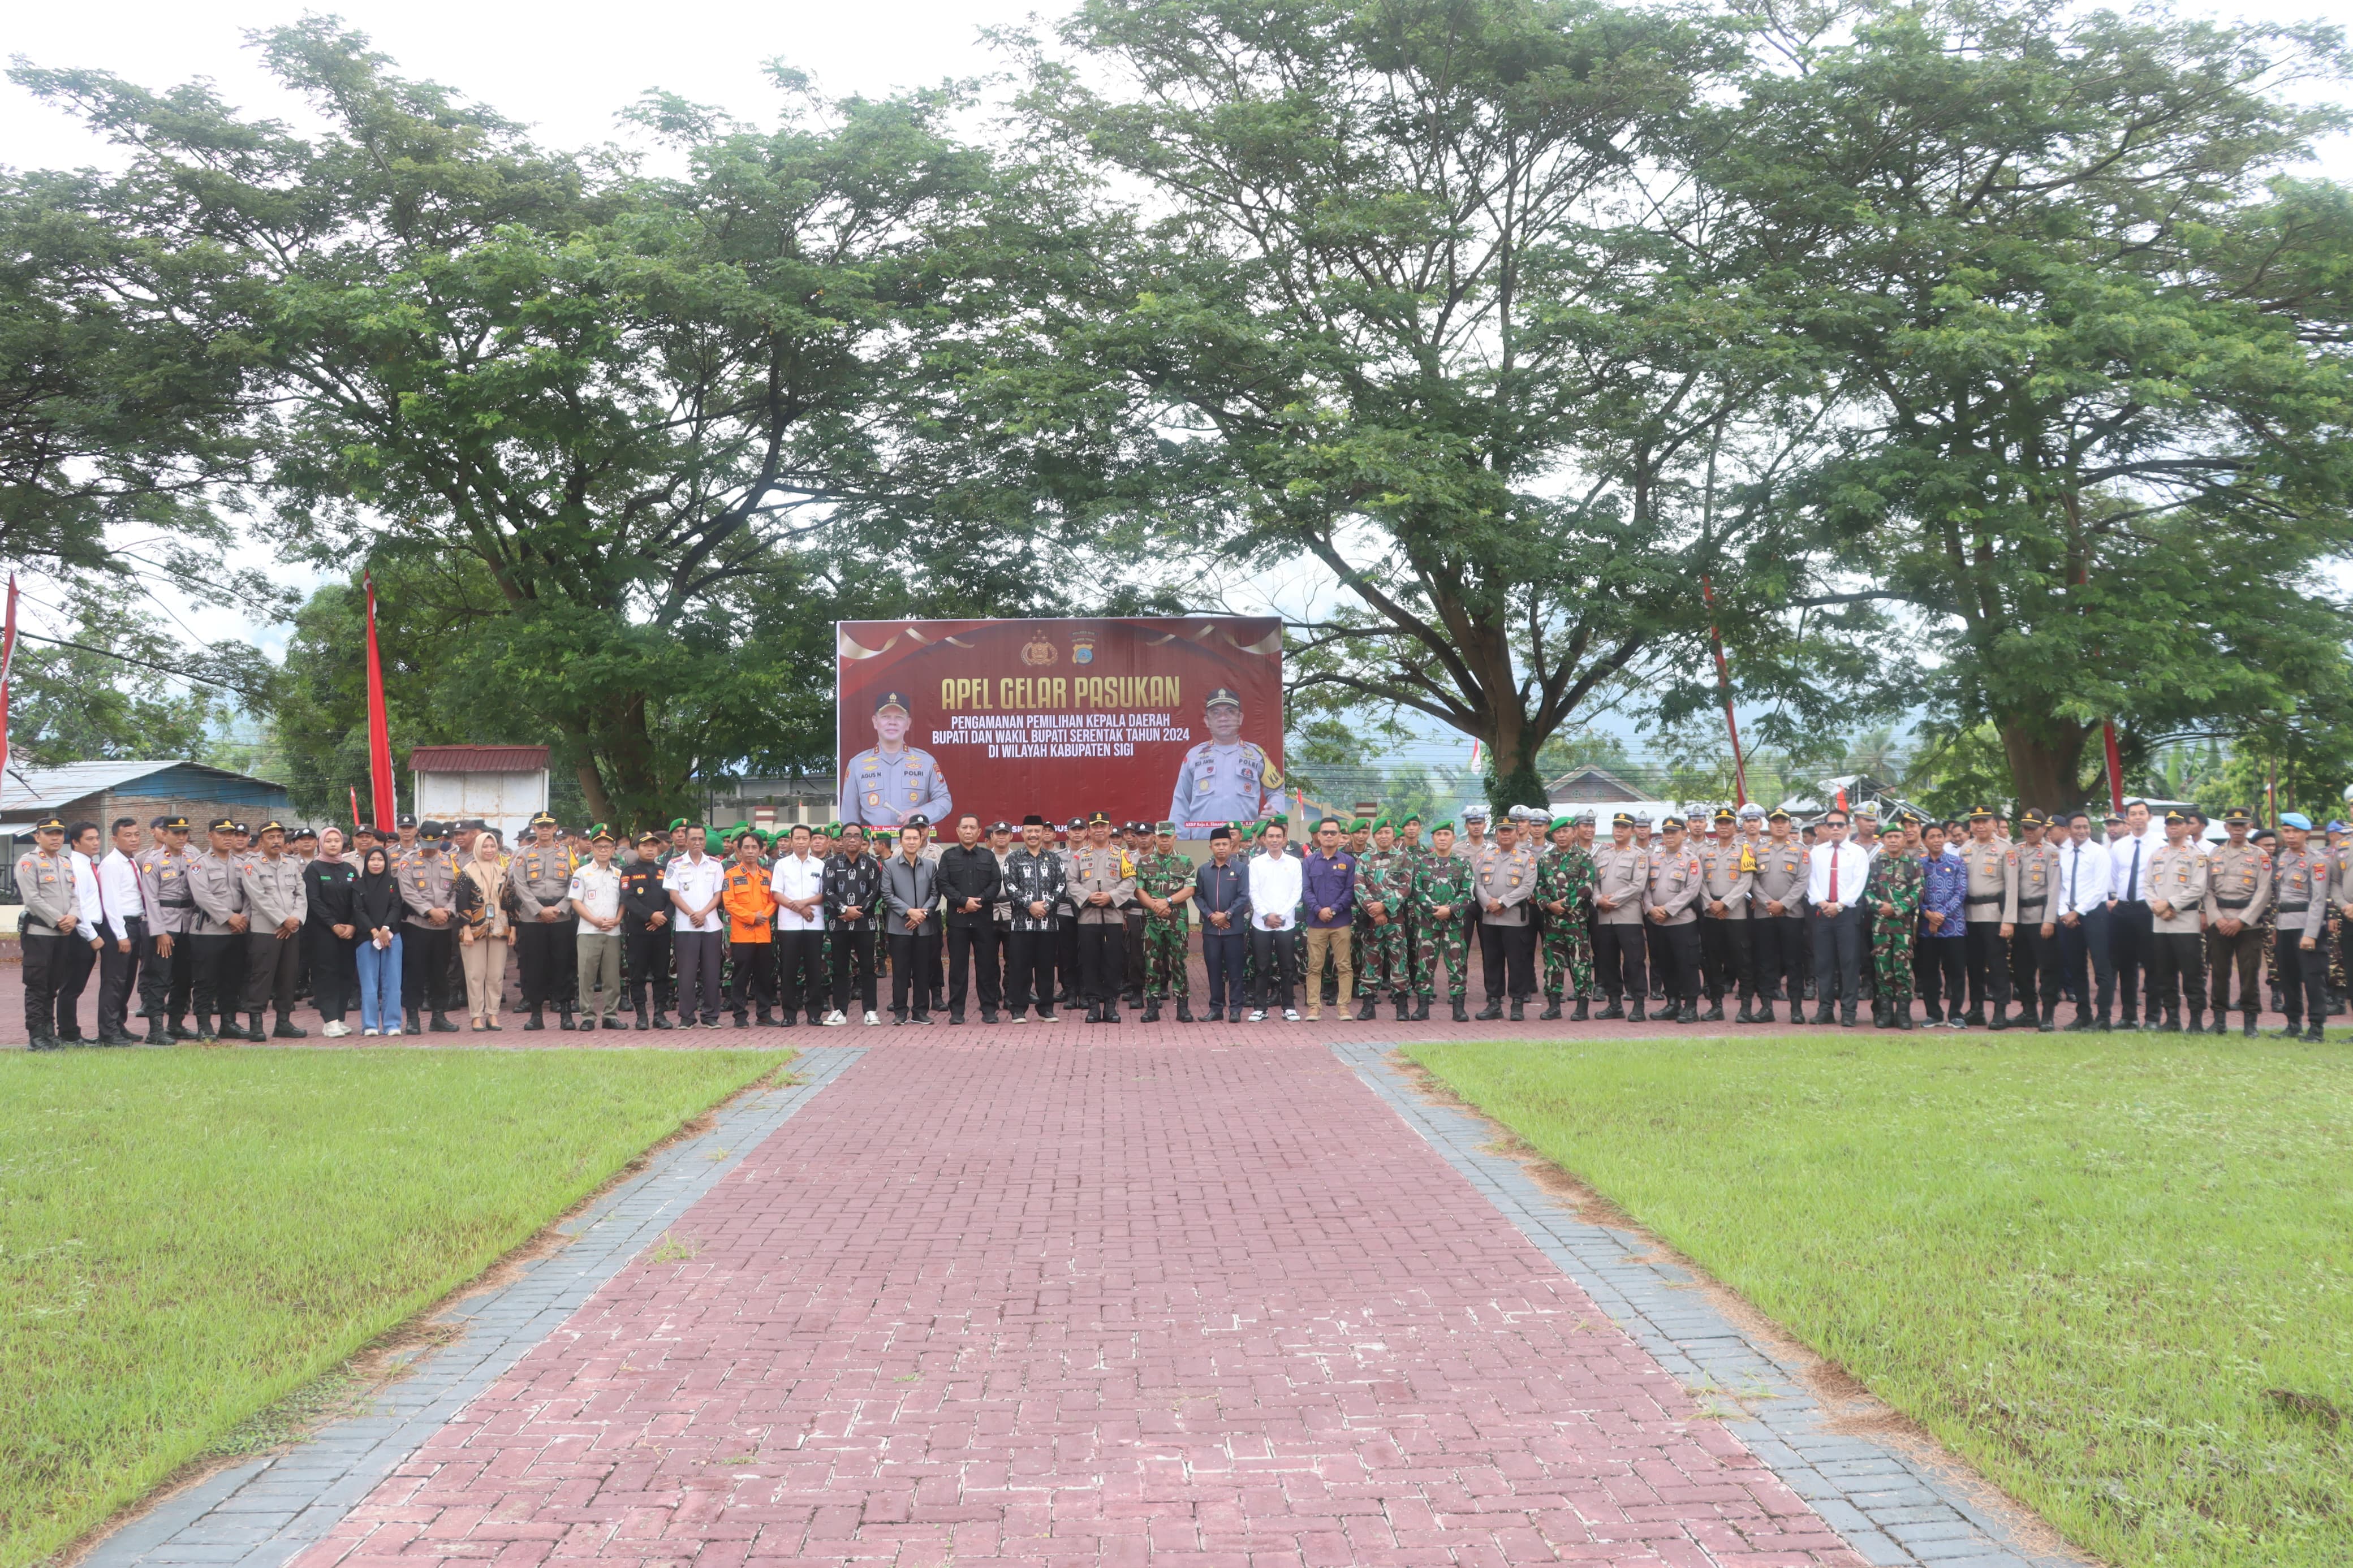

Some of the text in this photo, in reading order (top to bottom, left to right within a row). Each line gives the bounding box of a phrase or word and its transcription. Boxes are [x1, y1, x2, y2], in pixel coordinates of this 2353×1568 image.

[942, 676, 1180, 709] APEL GELAR PASUKAN
[951, 713, 1170, 729] PENGAMANAN PEMILIHAN KEPALA DAERAH
[932, 727, 1190, 744] BUPATI DAN WAKIL BUPATI SERENTAK TAHUN 2024
[988, 742, 1134, 758] DI WILAYAH KABUPATEN SIGI
[1238, 758, 1259, 769] POLRI
